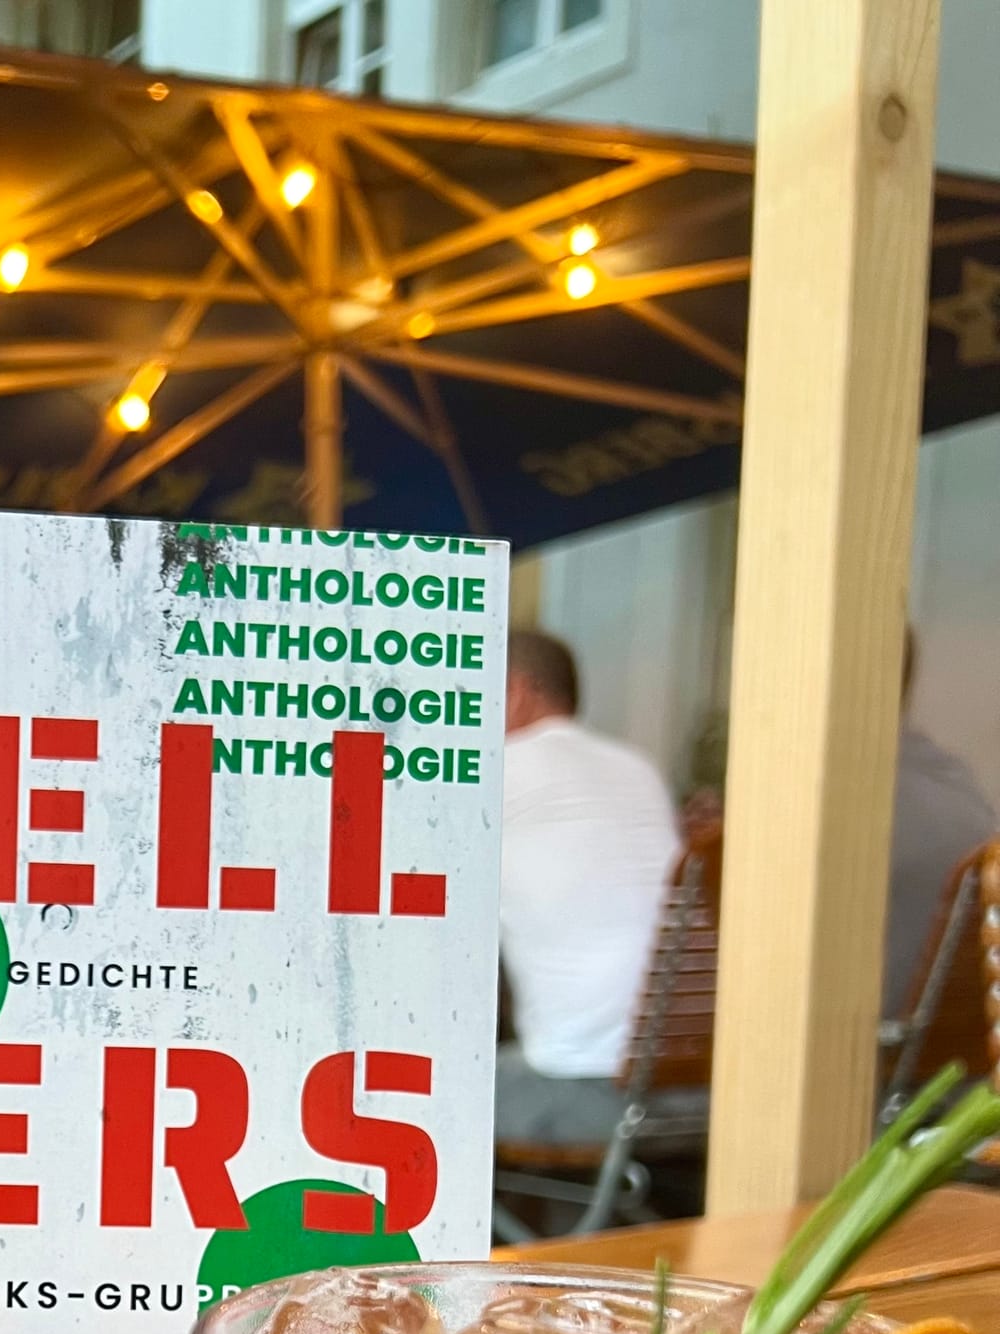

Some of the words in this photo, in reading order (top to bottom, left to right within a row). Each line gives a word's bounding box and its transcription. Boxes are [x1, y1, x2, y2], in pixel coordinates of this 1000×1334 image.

[176, 561, 485, 612] ANTHOLOGIE
[174, 620, 484, 670] ANTHOLOGIE
[172, 678, 482, 727] ANTHOLOGIE
[212, 738, 480, 784] NTHOOGIE
[7, 960, 199, 991] GEDICHTE
